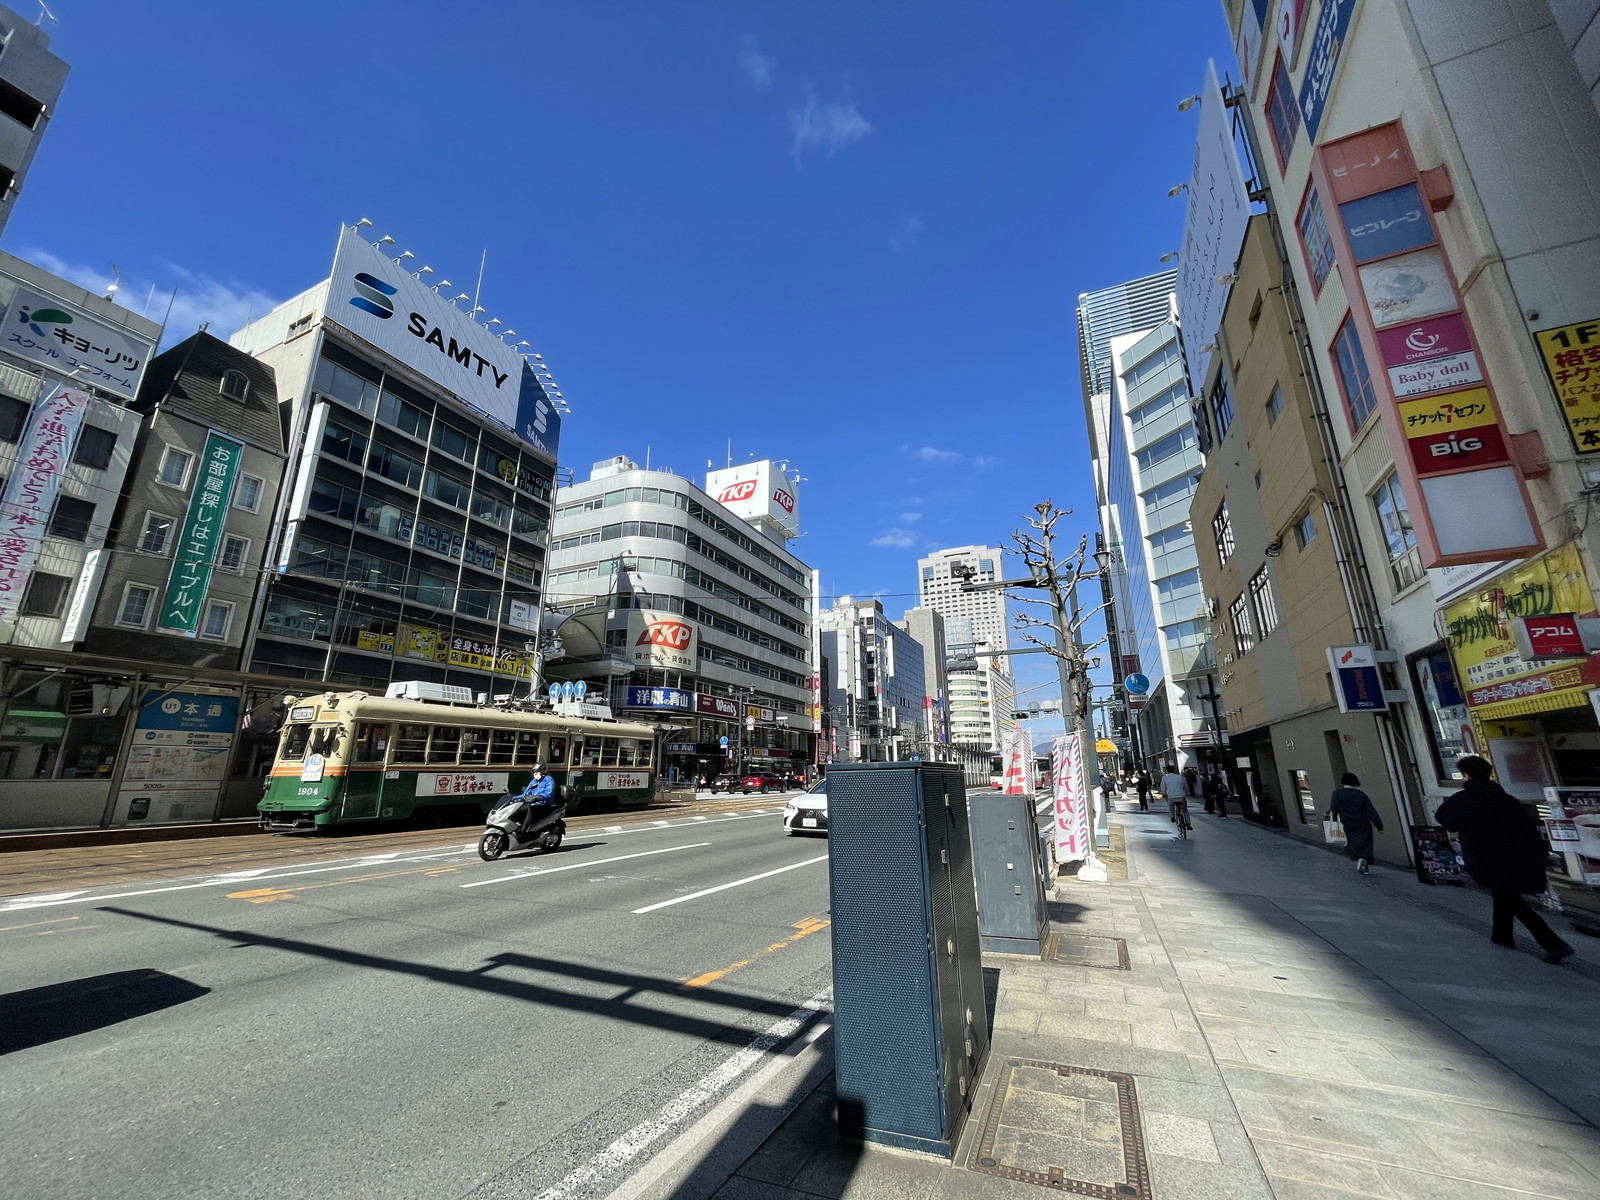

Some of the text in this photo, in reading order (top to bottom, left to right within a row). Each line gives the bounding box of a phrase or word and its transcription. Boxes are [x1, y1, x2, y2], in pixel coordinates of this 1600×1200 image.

[1551, 324, 1598, 348] 1F
[53, 327, 140, 371] キョーリツ
[408, 312, 508, 389] SAMTY
[1405, 346, 1449, 360] CHANSON
[8, 333, 131, 388] スクール ユニフォーム
[1398, 371, 1435, 384] Baby
[1440, 361, 1470, 376] doll
[526, 424, 549, 453] SAMT
[720, 482, 755, 502] TKP
[775, 489, 793, 509] TKP
[169, 445, 231, 624] お部屋探しはエイブルへ
[643, 624, 690, 646] TKP
[1530, 626, 1574, 638] アコム
[636, 689, 689, 708] 洋服の青山
[715, 698, 737, 717] Wants
[184, 702, 222, 717] 本通
[297, 787, 319, 796] 1904
